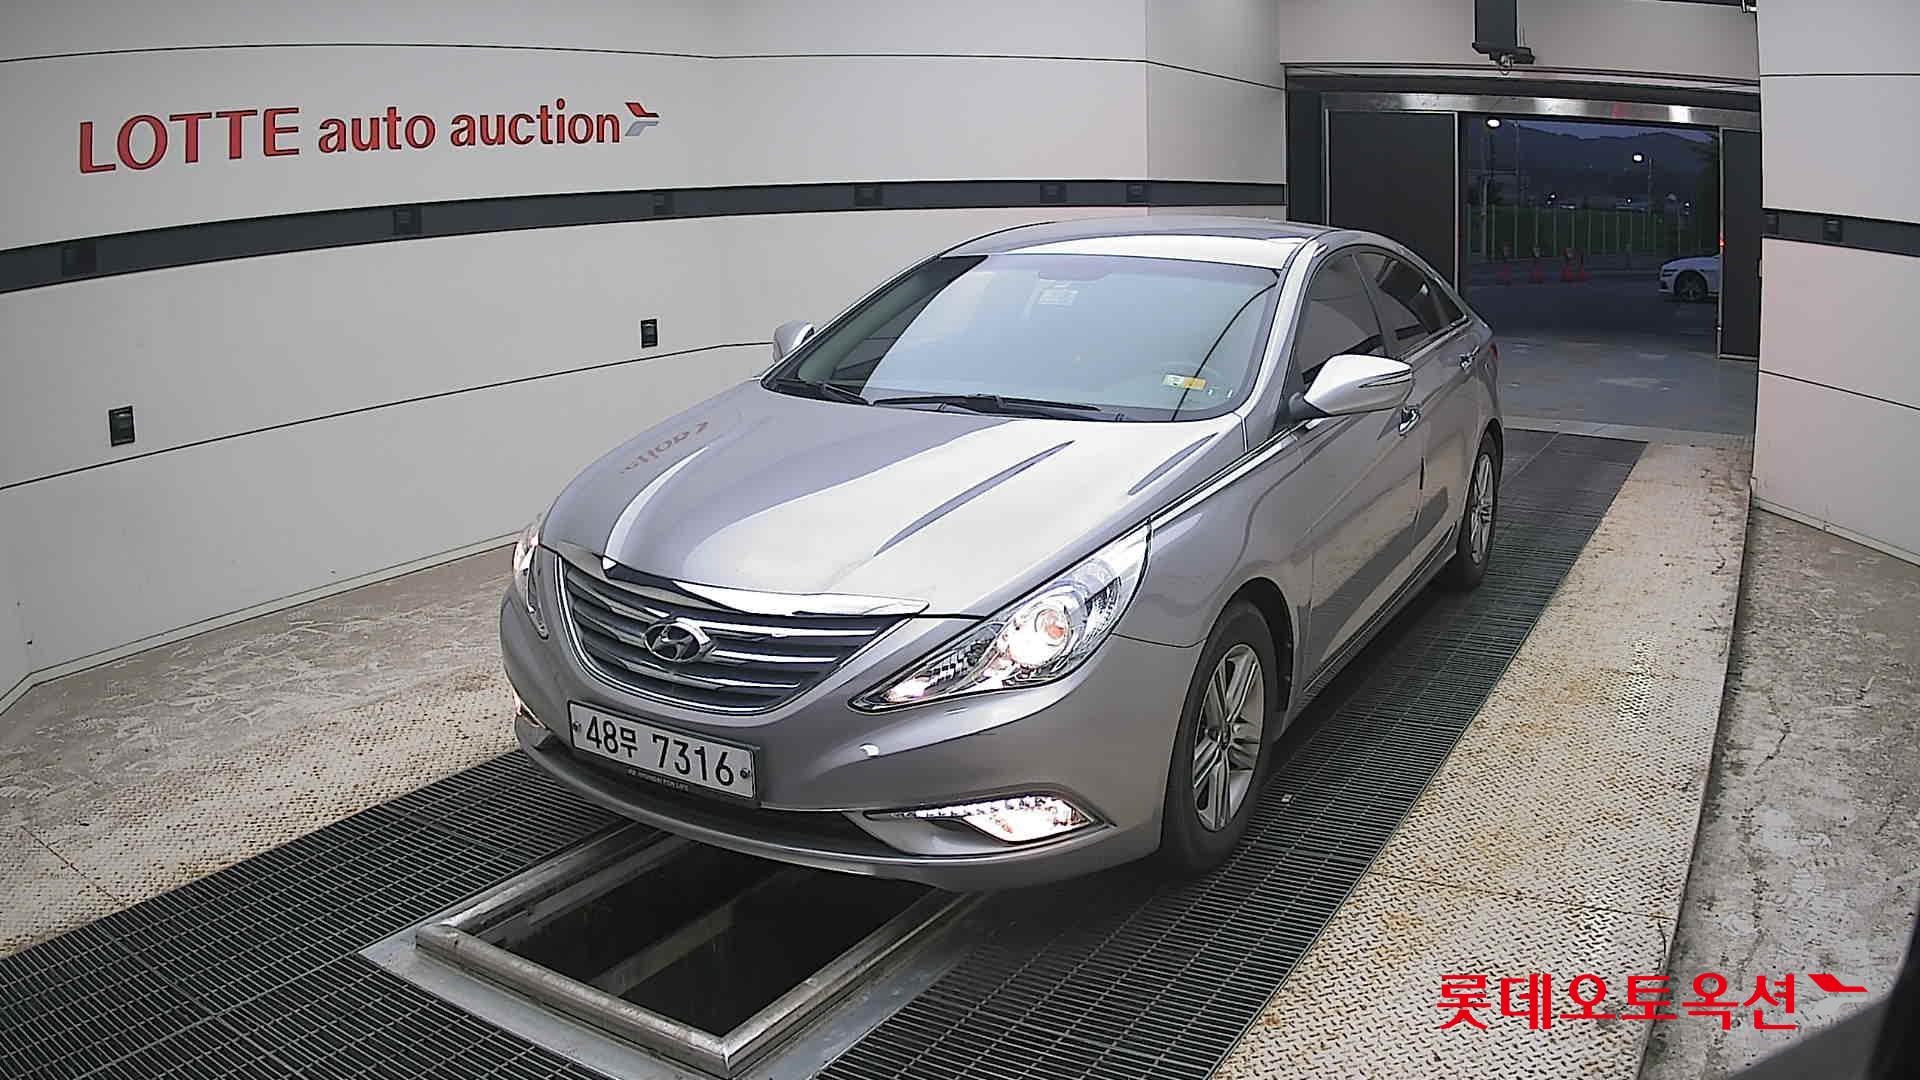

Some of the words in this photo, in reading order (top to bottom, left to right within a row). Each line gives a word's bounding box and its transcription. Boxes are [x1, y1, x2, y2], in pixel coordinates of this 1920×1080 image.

[79, 106, 301, 175] LOTTE
[318, 106, 438, 154] auto
[450, 98, 621, 145] auction
[586, 715, 638, 758] 48무
[652, 733, 735, 786] 7316
